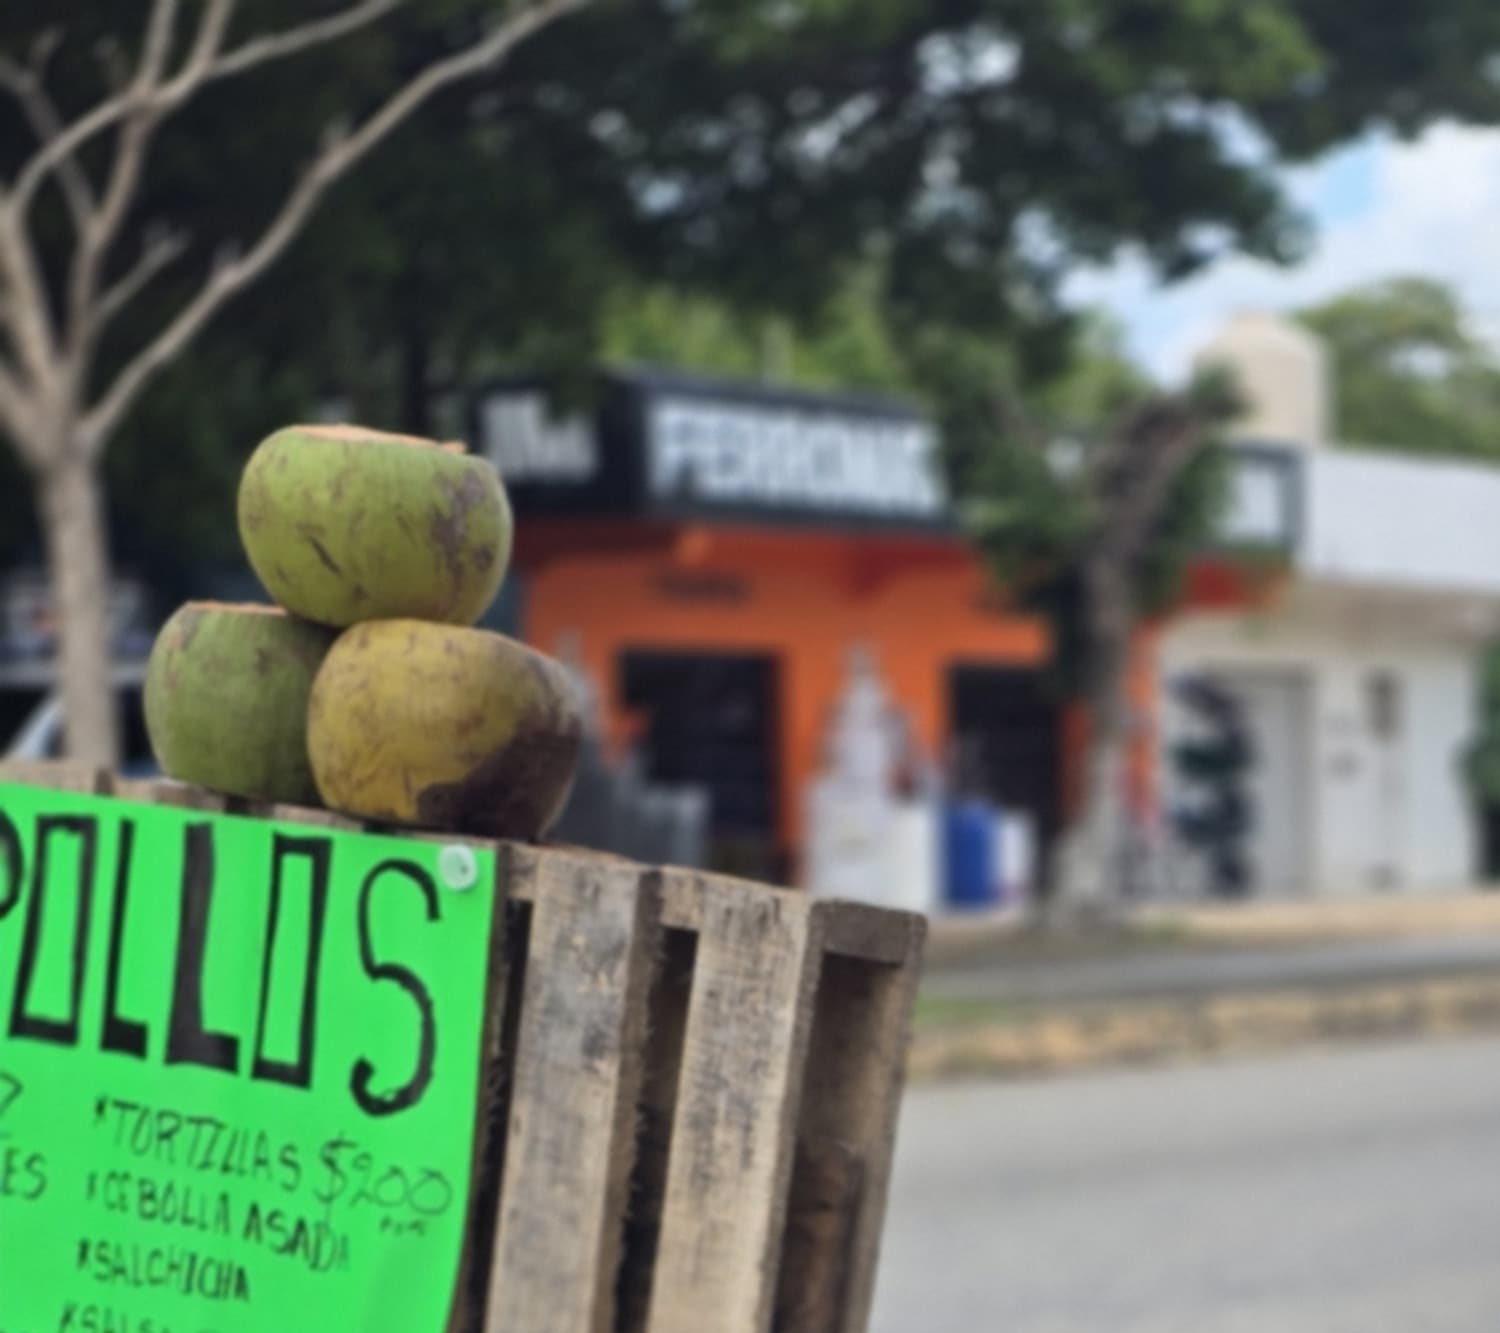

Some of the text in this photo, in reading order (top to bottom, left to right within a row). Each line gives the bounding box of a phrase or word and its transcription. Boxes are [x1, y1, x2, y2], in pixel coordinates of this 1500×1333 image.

[111, 1098, 302, 1194] TORTILLAS
[103, 1170, 350, 1272] CEBOLLA ASADA
[94, 1240, 251, 1303] SALCHICHA
